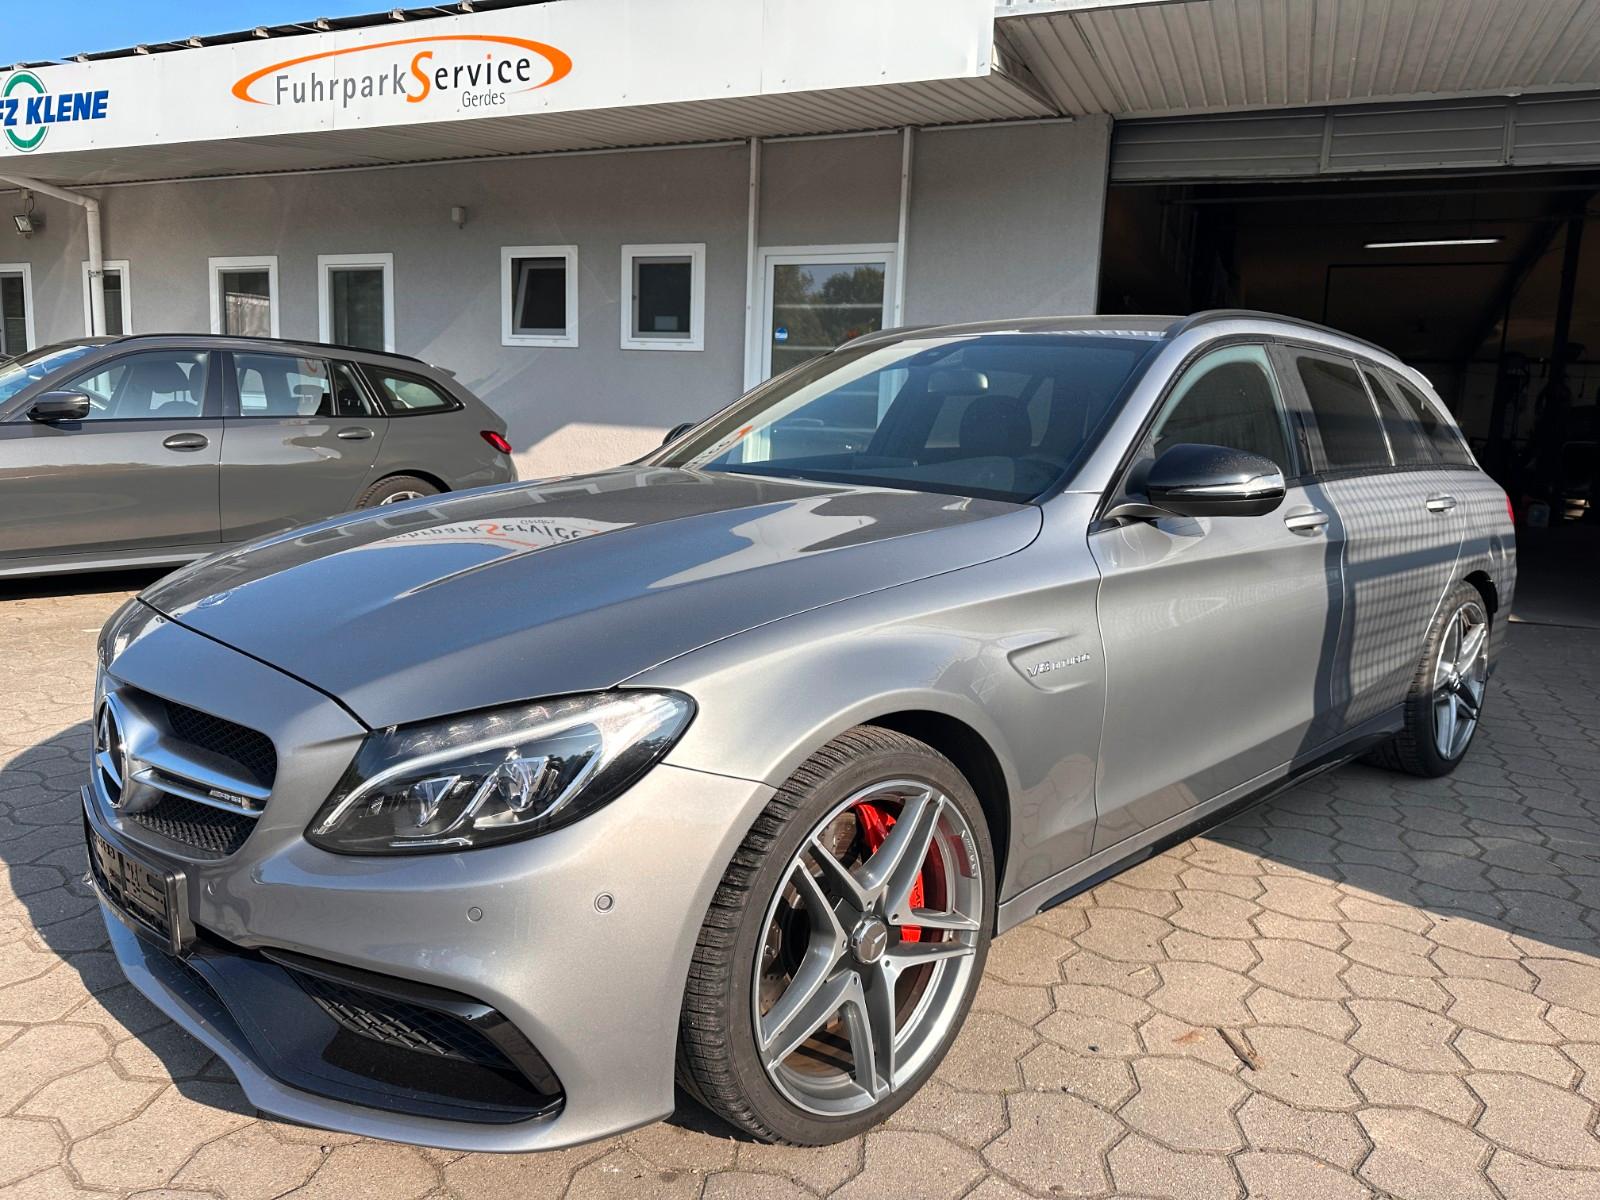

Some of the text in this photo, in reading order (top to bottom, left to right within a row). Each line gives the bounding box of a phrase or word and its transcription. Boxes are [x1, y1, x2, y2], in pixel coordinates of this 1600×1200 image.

[276, 51, 531, 108] FuhrparkService
[26, 90, 109, 125] KLENE
[462, 89, 506, 107] Gerdes
